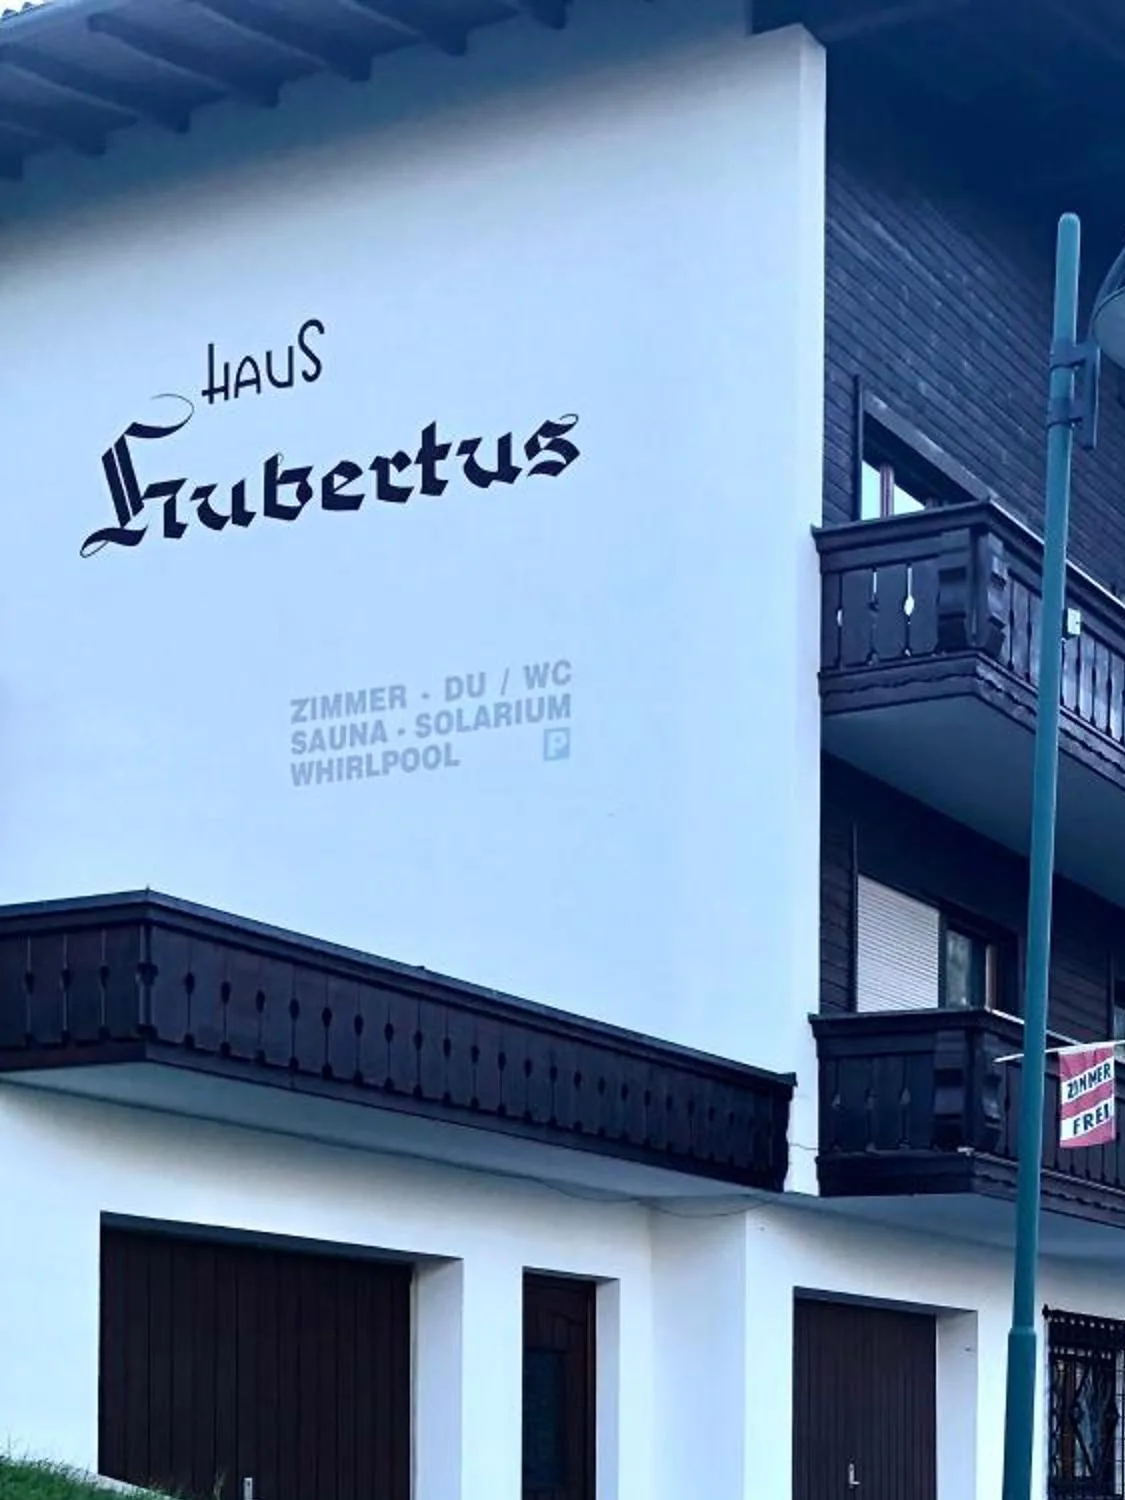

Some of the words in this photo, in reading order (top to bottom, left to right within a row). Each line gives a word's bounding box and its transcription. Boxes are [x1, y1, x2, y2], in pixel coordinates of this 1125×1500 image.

[202, 319, 325, 404] HAUS
[80, 393, 580, 559] Hubertus
[290, 684, 408, 724] ZIMMER
[445, 671, 486, 702] DU
[523, 659, 572, 690] WC
[290, 719, 388, 755] SAUNA
[415, 693, 571, 739] SOLARIUM
[290, 742, 460, 787] WHIRLPOOL
[1067, 1063, 1112, 1099] ZIMMER
[1073, 1103, 1109, 1135] FREI
